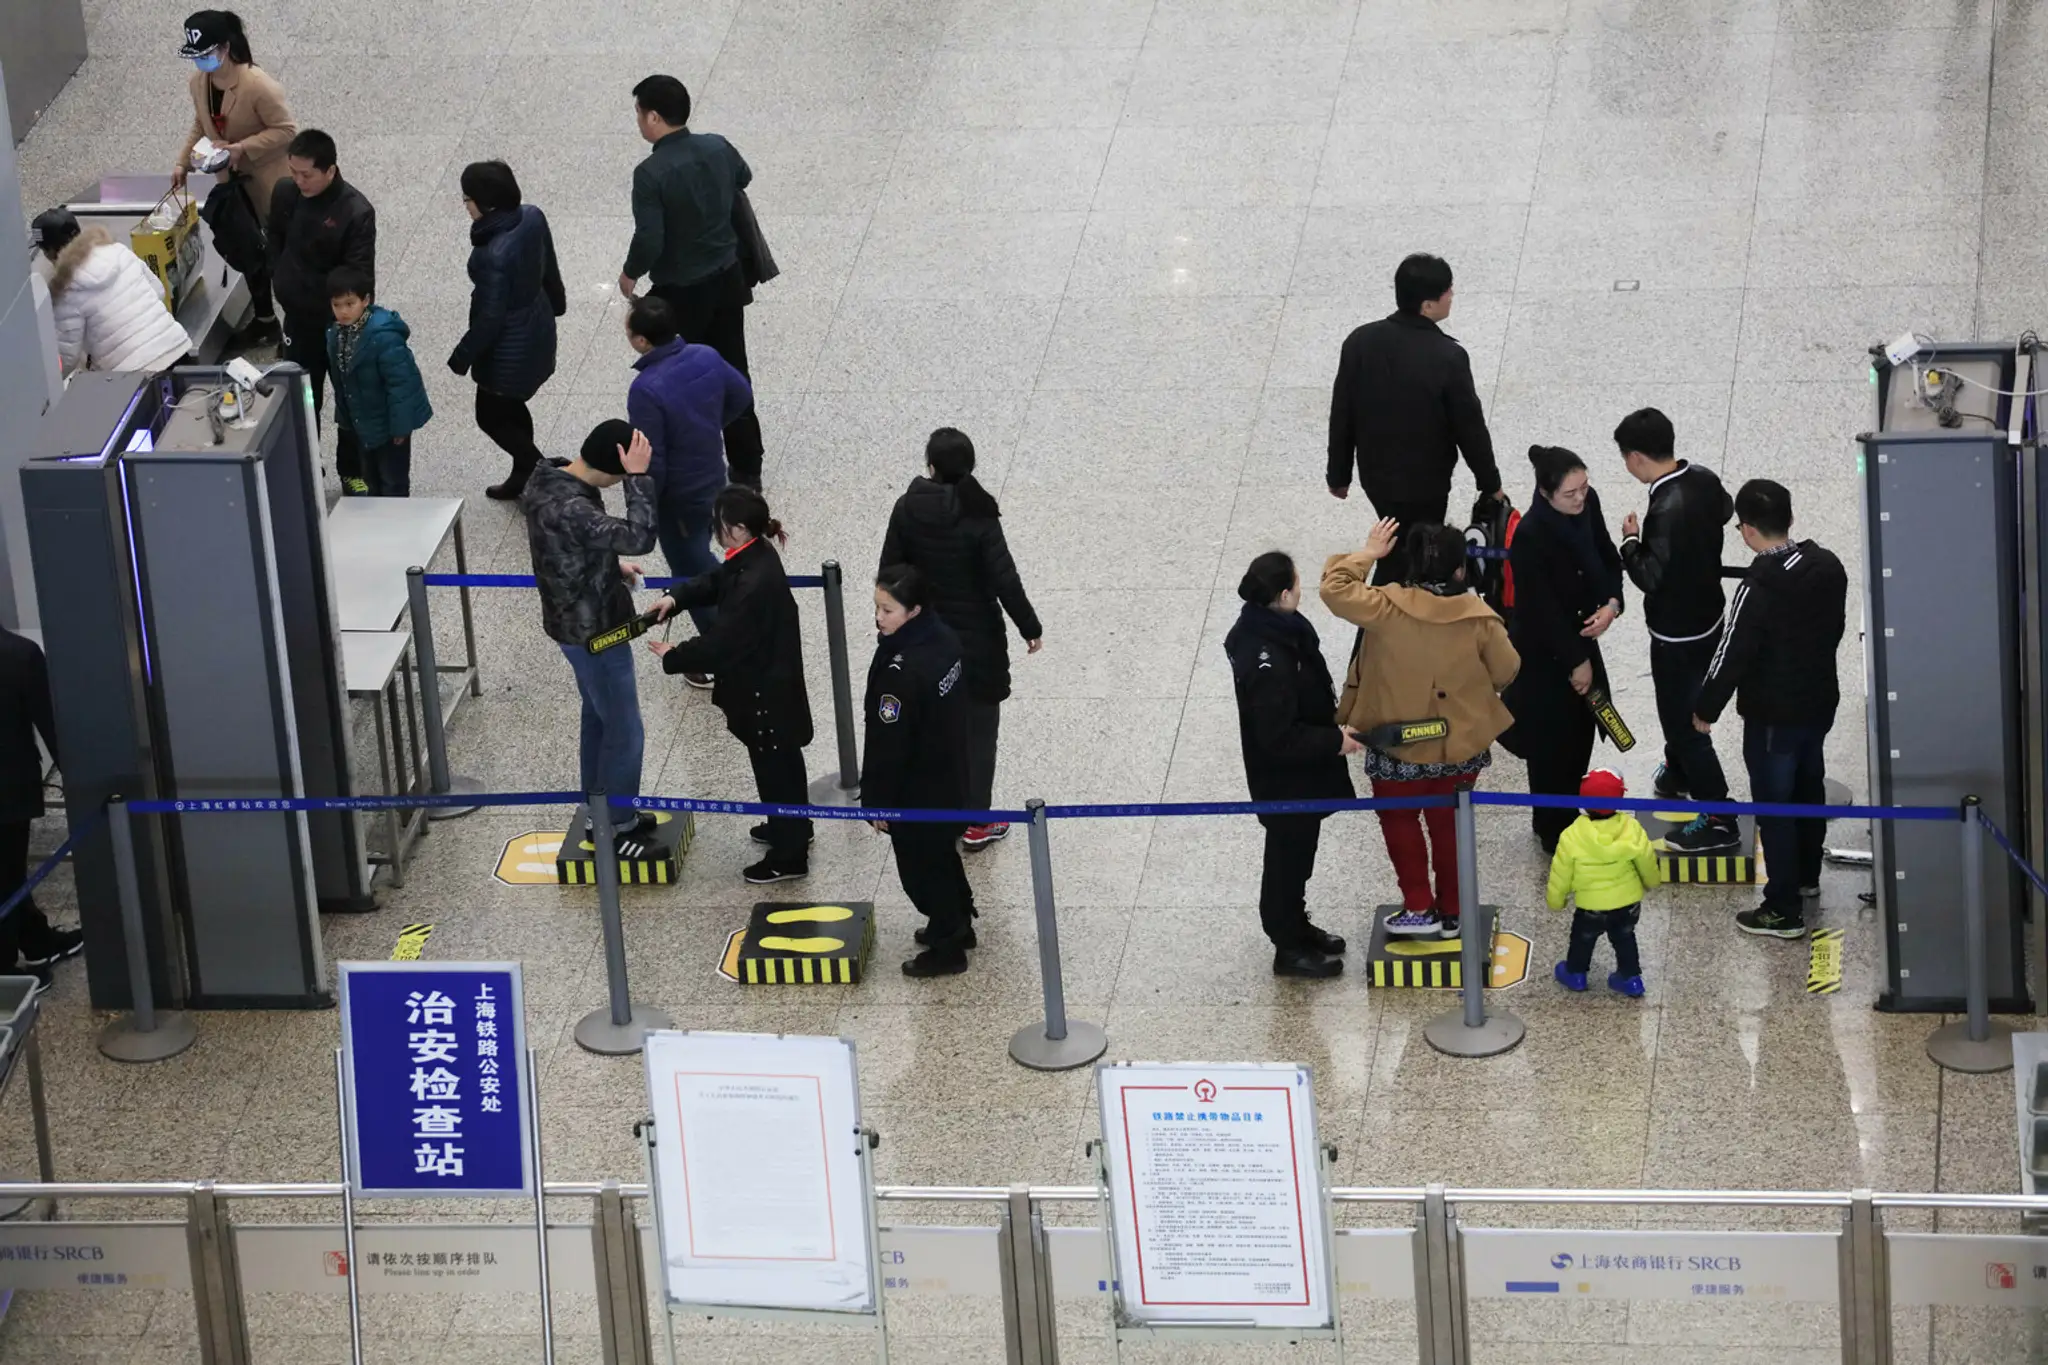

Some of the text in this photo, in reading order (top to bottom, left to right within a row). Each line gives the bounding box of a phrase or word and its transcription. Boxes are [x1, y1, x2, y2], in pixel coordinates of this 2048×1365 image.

[593, 627, 628, 650] SCANNER
[1601, 708, 1631, 747] SCANNER
[474, 983, 502, 1113] 上海铁路公安处
[405, 990, 465, 1176] 治安检查站
[1152, 1112, 1264, 1122] 铁路禁止携带物品目录
[53, 1246, 104, 1261] SRCB
[367, 1252, 498, 1266] 请依次按顺序排队
[1579, 1253, 1741, 1271] 上海农商银行 SRCB
[384, 1267, 411, 1277] Please
